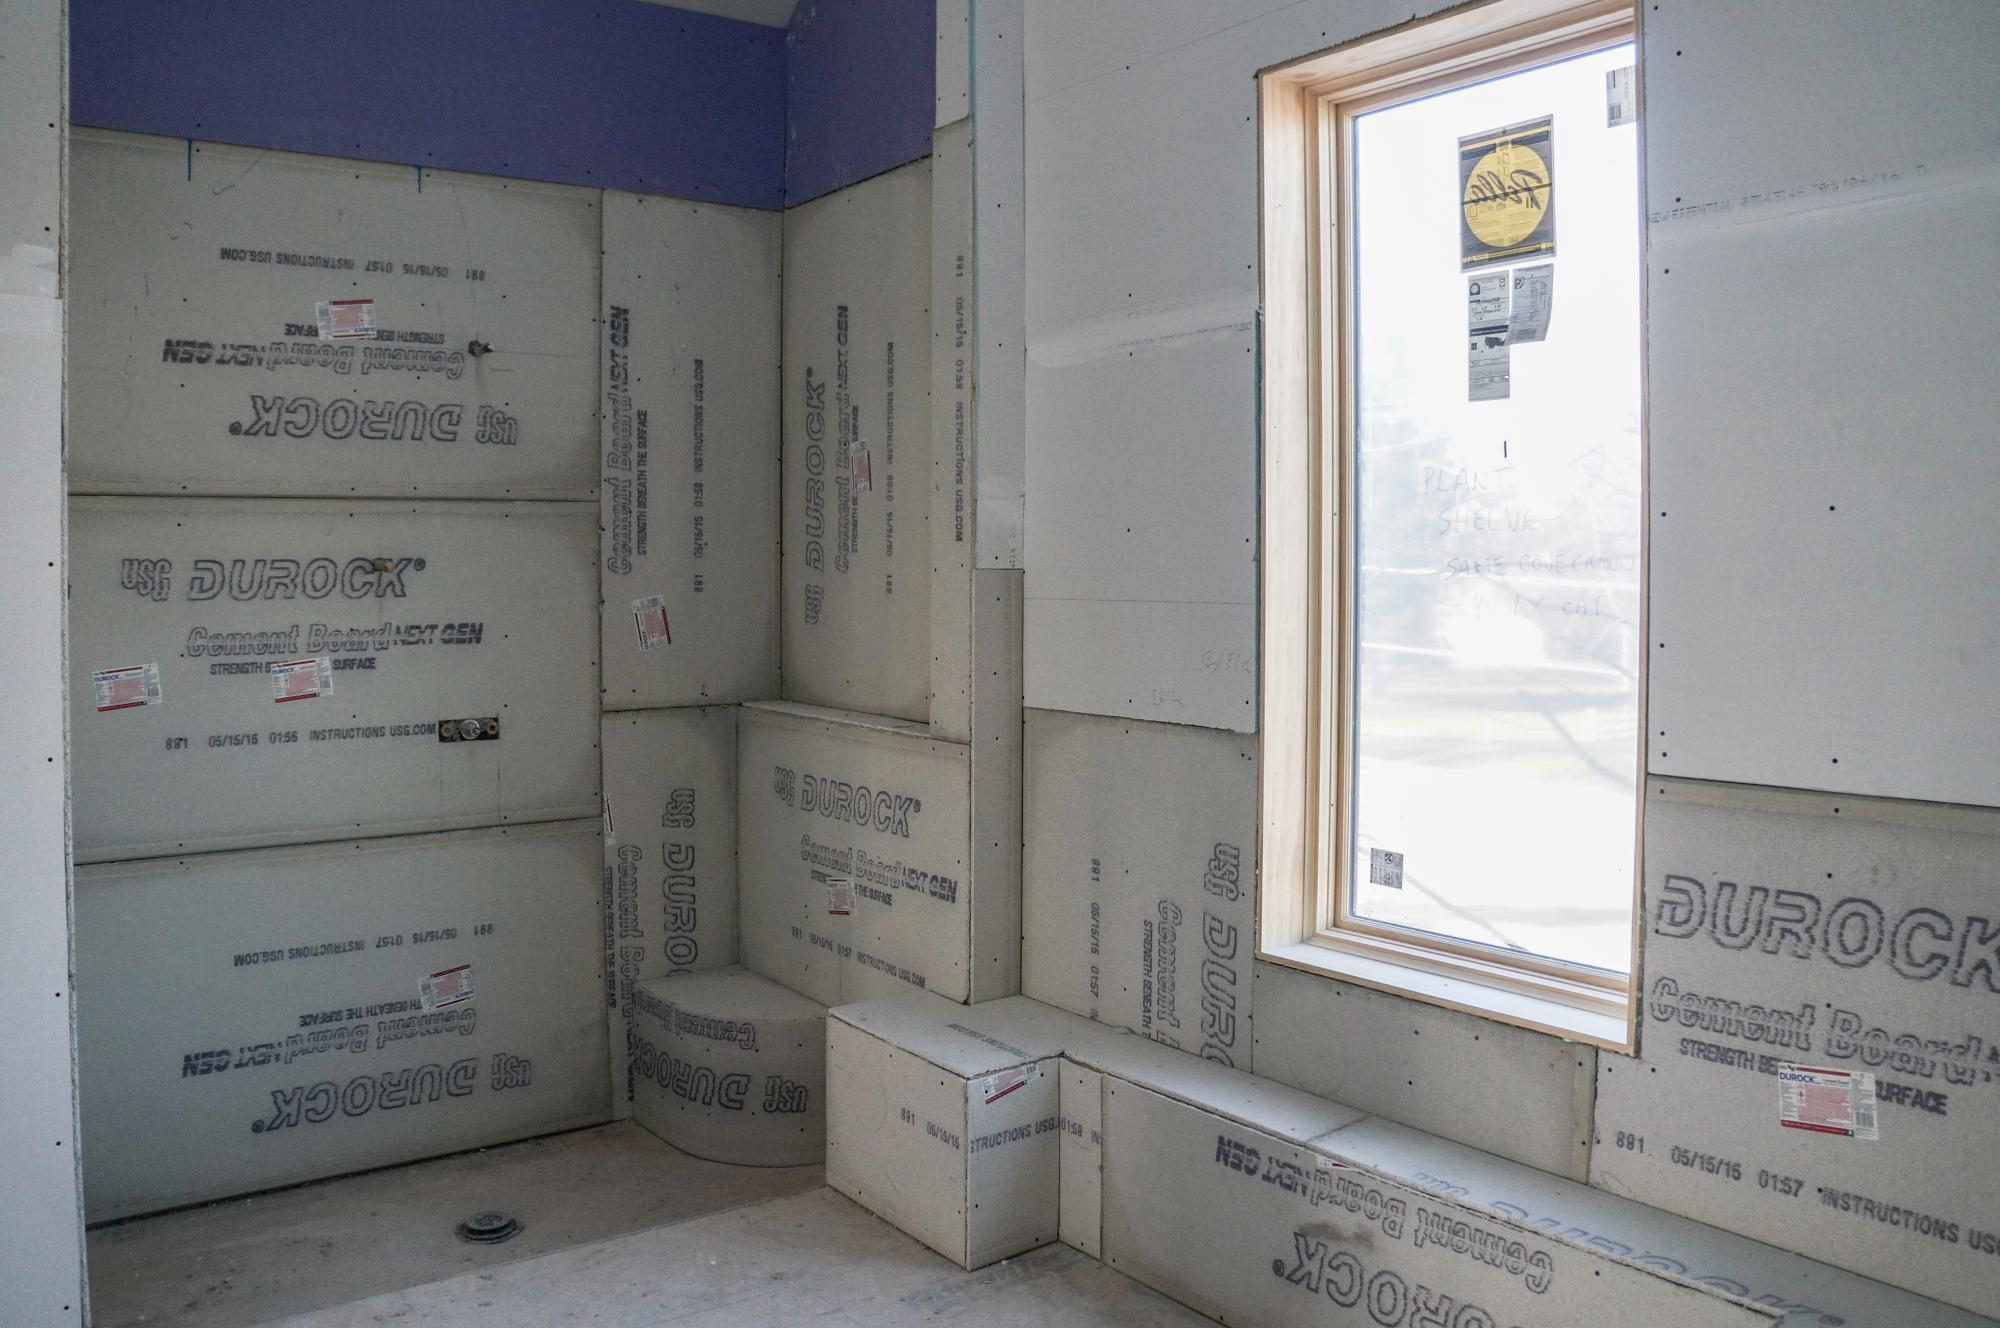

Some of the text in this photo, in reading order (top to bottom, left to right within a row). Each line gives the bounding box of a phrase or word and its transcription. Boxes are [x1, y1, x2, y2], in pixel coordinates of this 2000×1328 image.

[220, 247, 271, 263] USG.COM
[275, 253, 354, 271] INSTRUCTIONS
[161, 338, 465, 380] Cement Board NEXT GEN
[396, 330, 445, 345] STRENGTH
[694, 359, 703, 401] USG.COM
[607, 305, 632, 575] Cement Board NEXT GEN
[694, 404, 703, 472] INSTRUCTIONS
[834, 305, 850, 574] Cement Board NEXT GEN
[955, 401, 964, 485] INSTRUCTIONS
[637, 409, 648, 556] STRENGTH BENEATH THE SURFACE
[955, 489, 964, 542] USG.COM
[121, 558, 172, 602] USG
[185, 622, 485, 658] Cement Board NEXT GEN
[209, 661, 263, 676] STRENGTH
[332, 656, 376, 674] SURFACE
[309, 725, 386, 741] INSTRUCTIONS
[389, 723, 436, 738] USG.COM
[661, 787, 698, 976] USG DURO
[800, 833, 853, 875] Cement
[855, 849, 901, 890] Board
[901, 866, 929, 894] NEXT
[928, 874, 958, 904] GEN
[1203, 842, 1240, 902] USG
[617, 845, 644, 939] Cement
[233, 948, 285, 968] USG.COM
[288, 939, 366, 962] INSTRUCTIONS
[856, 951, 897, 977] INSTRUCTIONS
[898, 967, 926, 988] USG.COM
[1143, 919, 1153, 978] STRENGTH
[1156, 899, 1183, 1030] Cement
[299, 1013, 344, 1028] SURFACE
[345, 1007, 364, 1022] THE
[367, 1001, 408, 1021] BENEATH
[1142, 978, 1152, 1028] BENEATH
[181, 1009, 477, 1078] Cement Board NEXT GEN
[1650, 976, 1817, 1052] Cement
[1825, 1008, 1983, 1087] Board
[1679, 1037, 1756, 1072] STRENGTH
[763, 1075, 808, 1114] USG
[1215, 1135, 1261, 1177] GEN
[1262, 1155, 1312, 1198] NEXT
[1311, 1168, 1407, 1240] Board
[1615, 1130, 1645, 1153] 891
[1758, 1170, 1804, 1198] 01:57
[1822, 1187, 1959, 1244] INSTRUCTIONS
[1414, 1207, 1554, 1295] Cement
